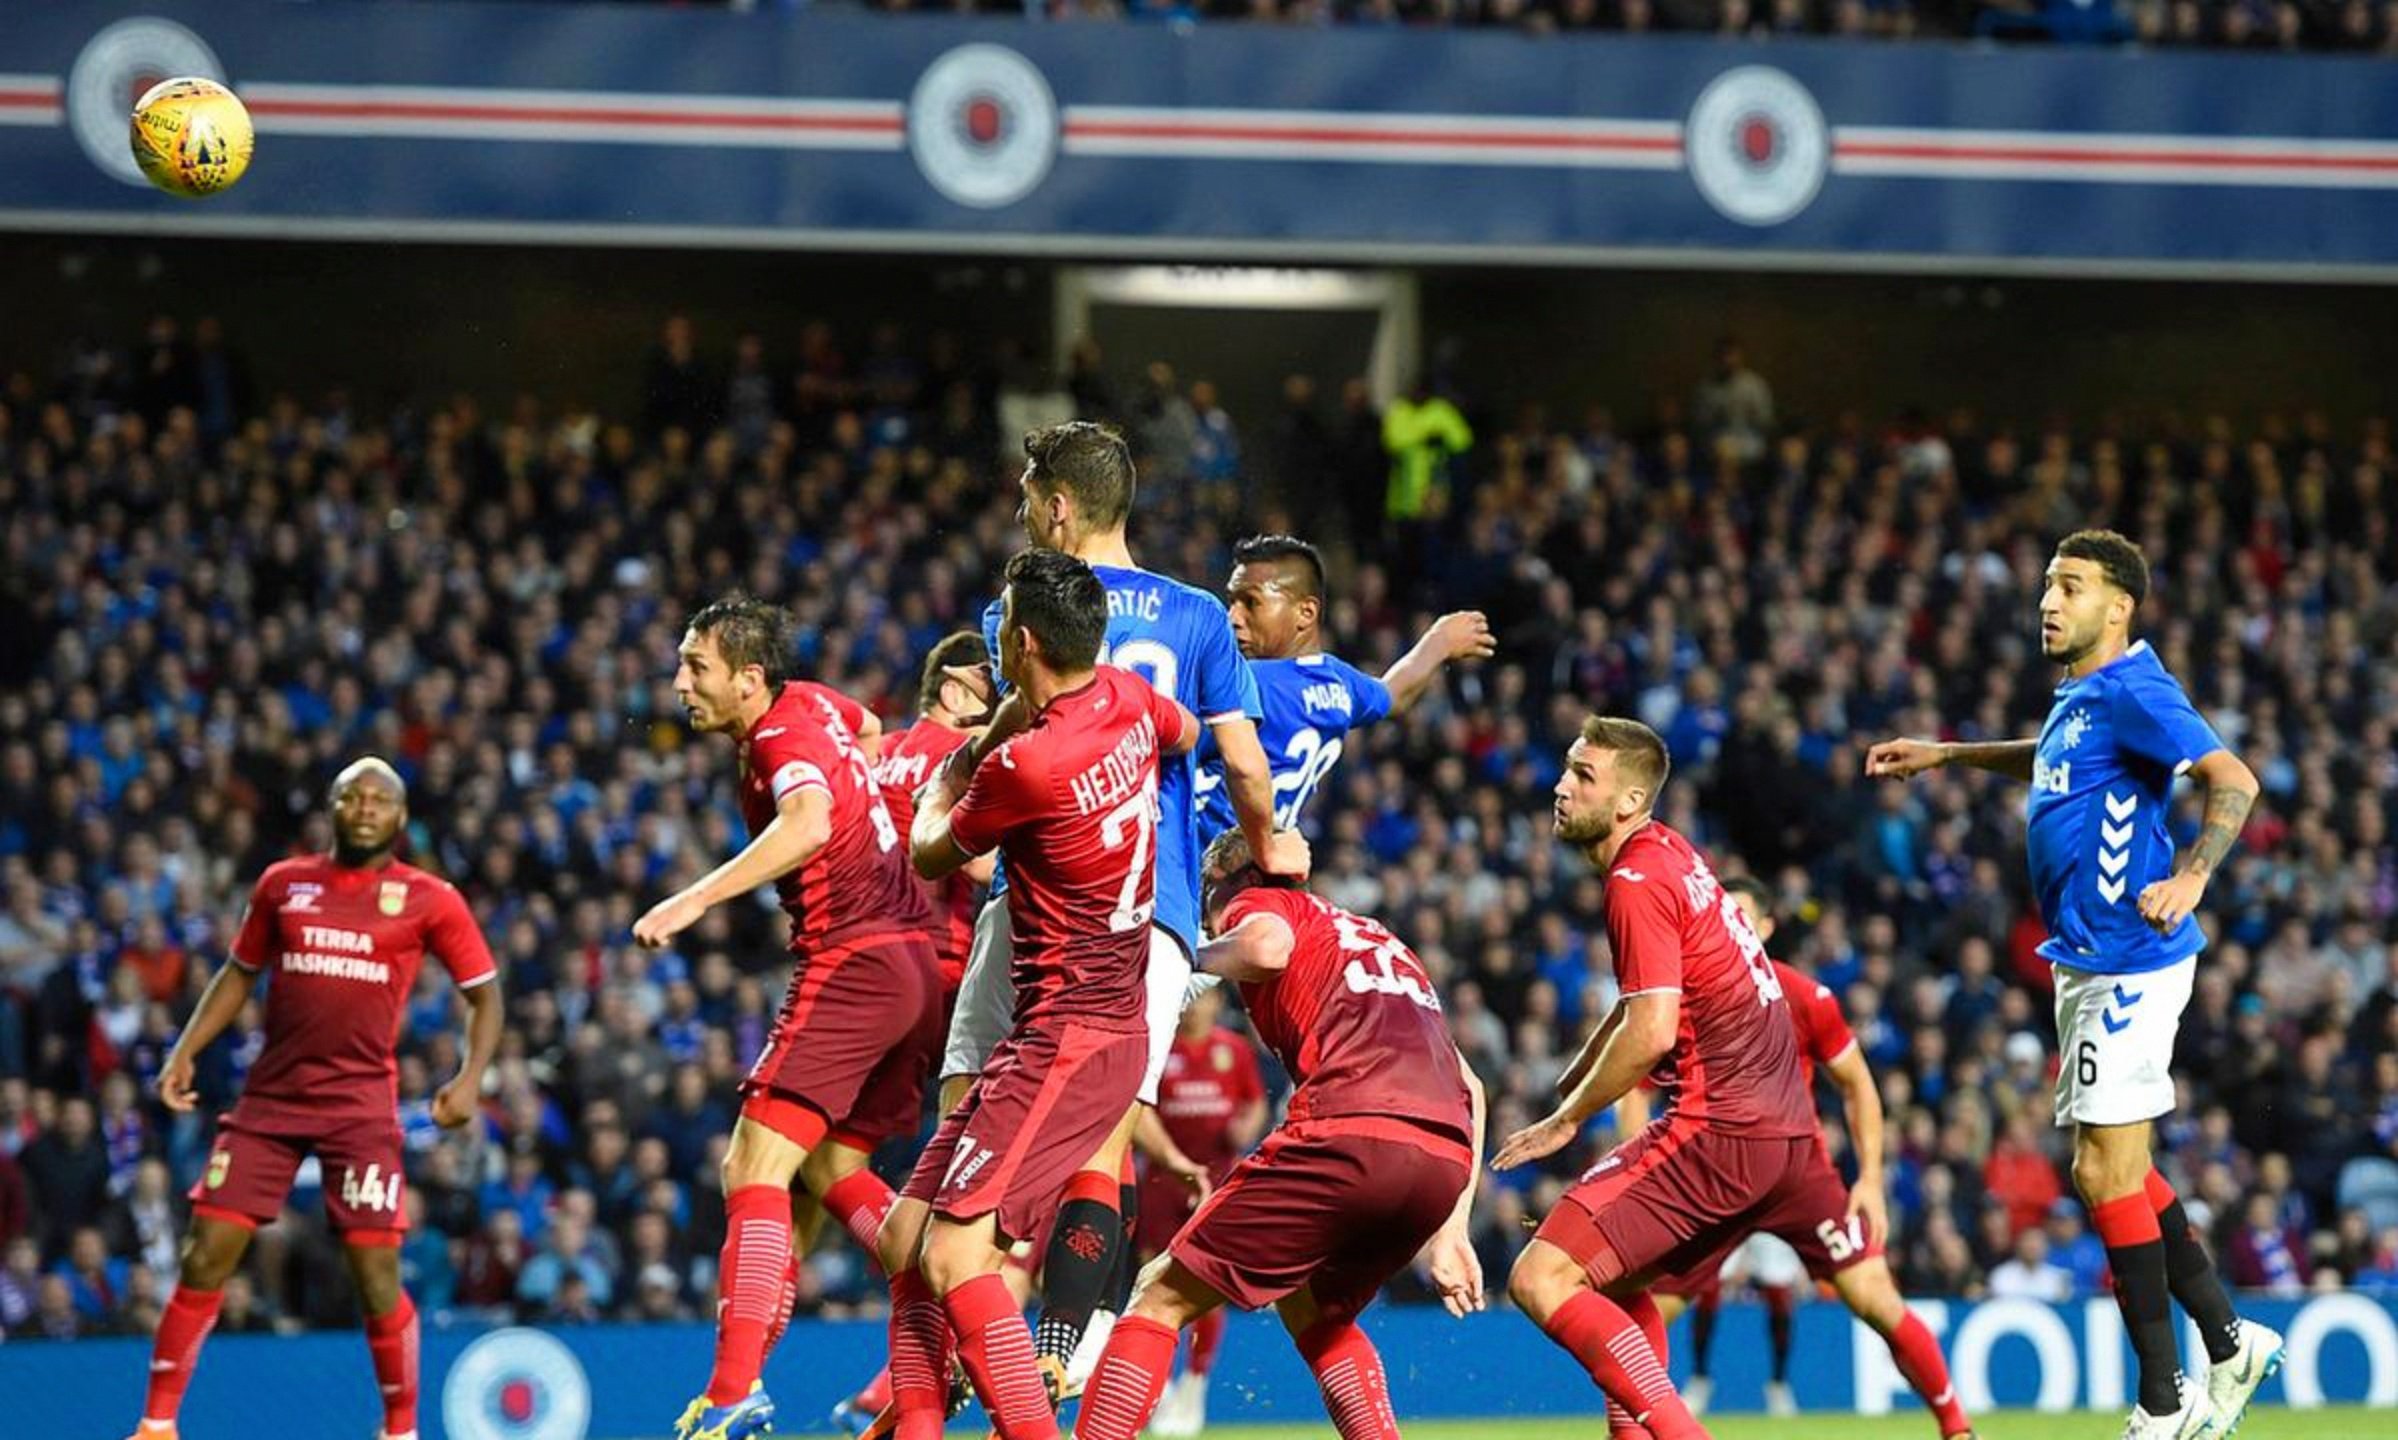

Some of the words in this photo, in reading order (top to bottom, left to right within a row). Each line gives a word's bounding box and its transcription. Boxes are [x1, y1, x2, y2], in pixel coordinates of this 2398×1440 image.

[141, 111, 181, 133] mitre
[302, 925, 374, 955] TERRA
[282, 952, 389, 984] BASHKIRIA
[2078, 1040, 2097, 1086] 6
